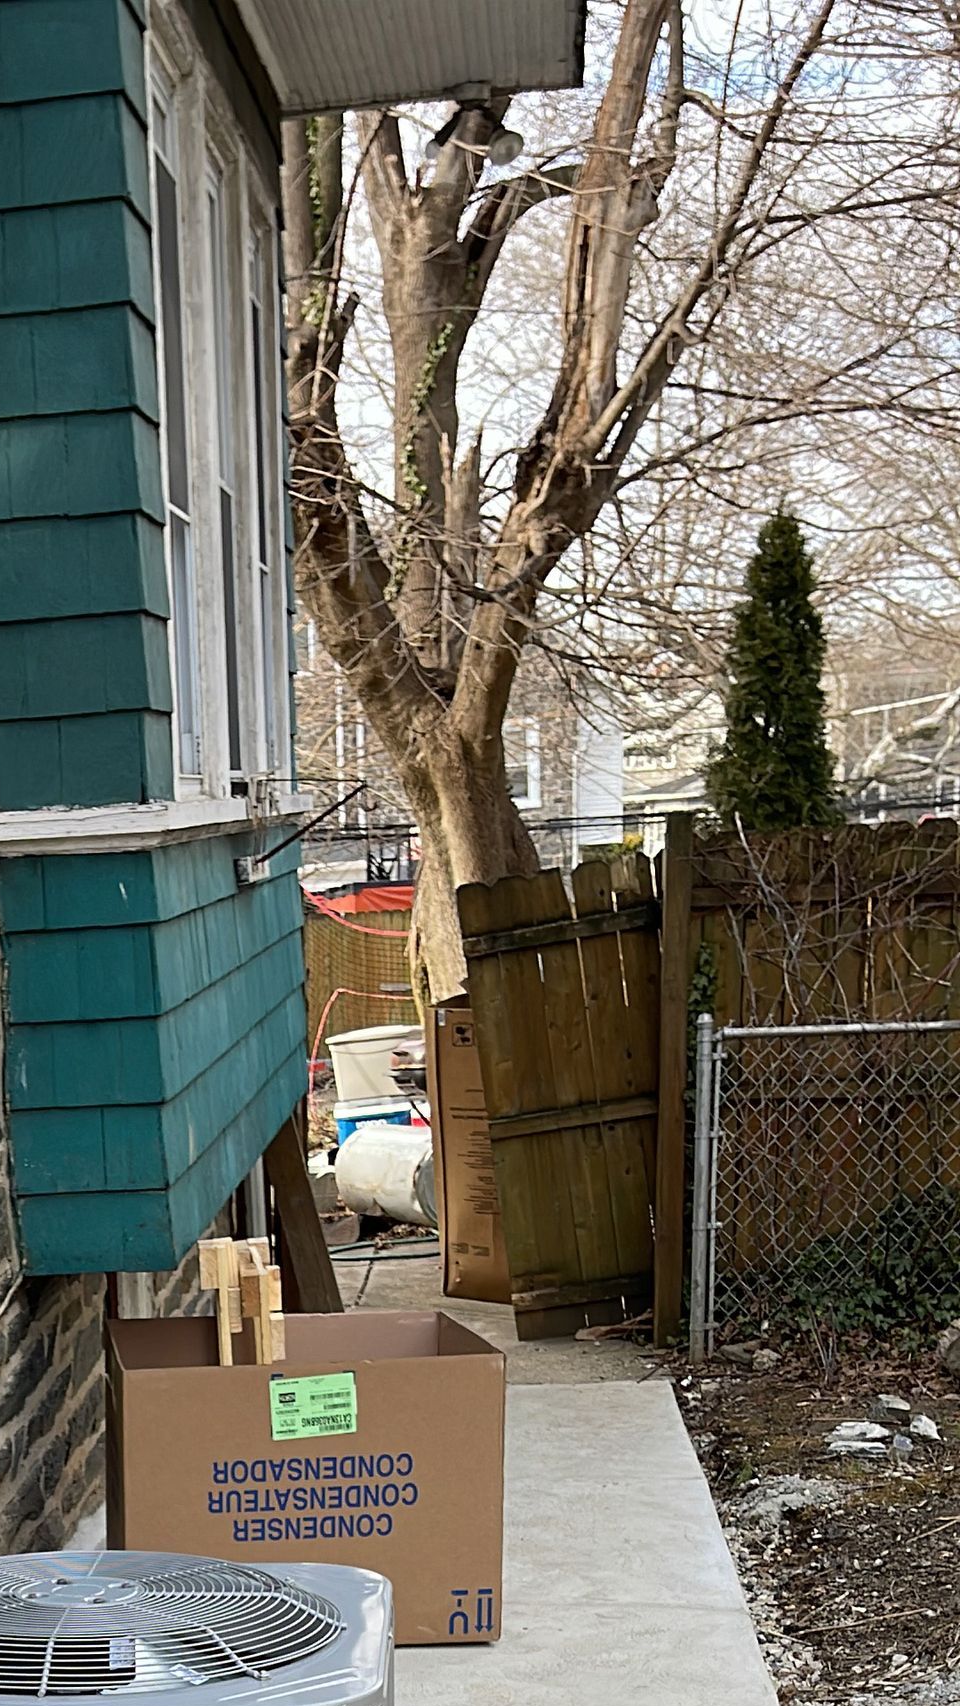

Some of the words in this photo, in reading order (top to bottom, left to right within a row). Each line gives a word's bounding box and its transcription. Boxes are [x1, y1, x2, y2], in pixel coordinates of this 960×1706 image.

[213, 1453, 414, 1484] CONDENSADOR
[208, 1482, 419, 1514] CONDENSATEUR
[233, 1513, 393, 1541] CONDENSER
